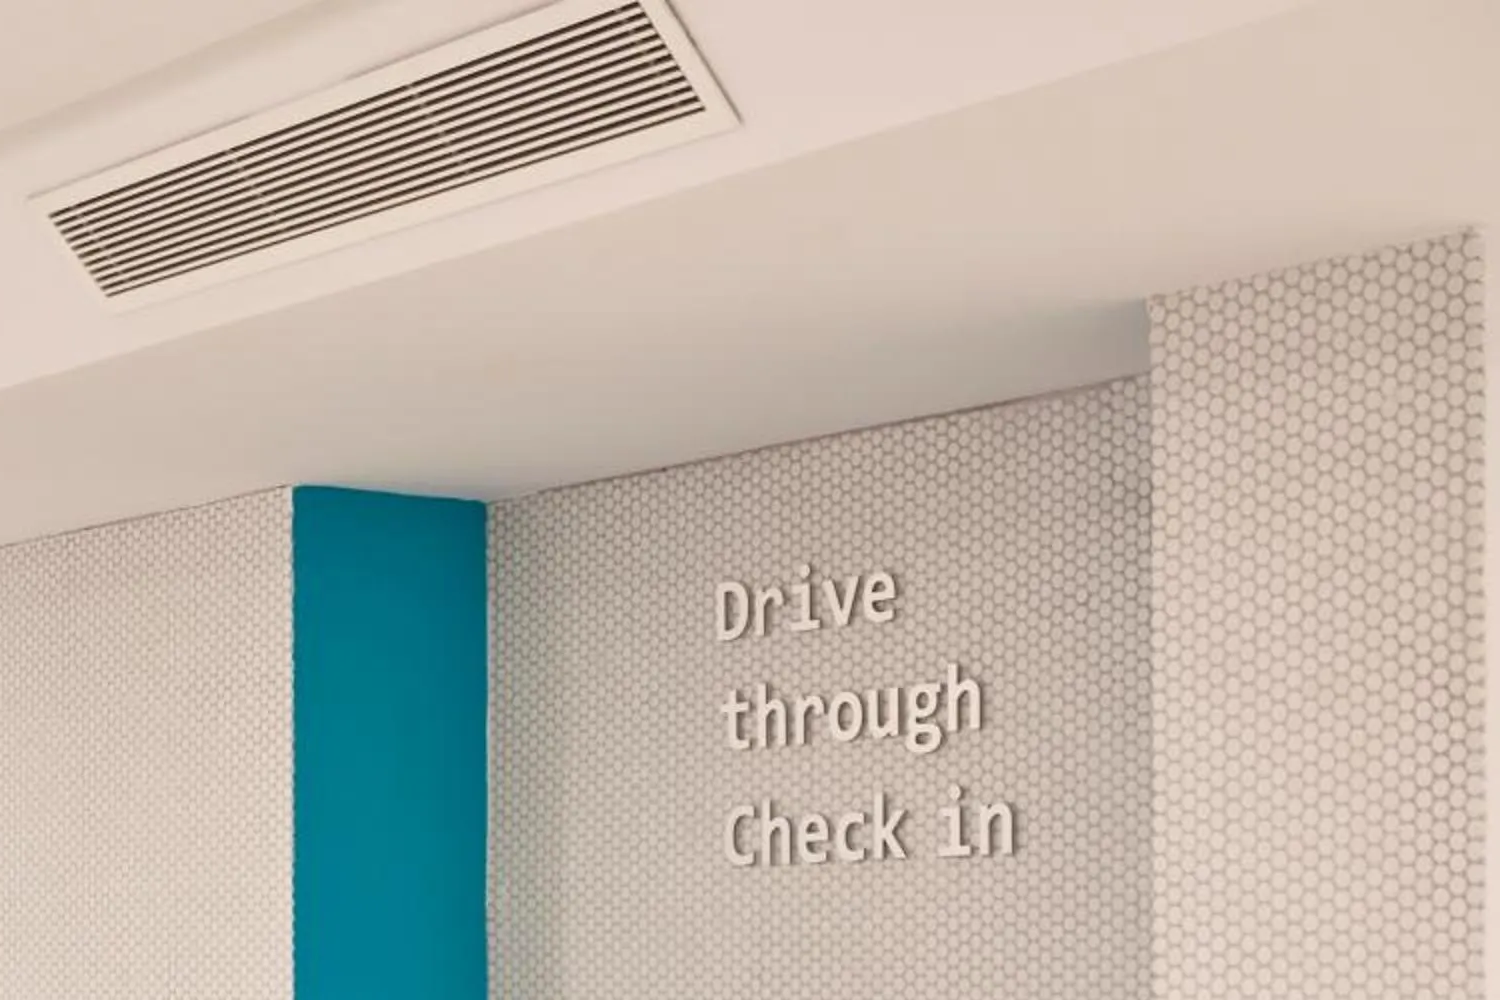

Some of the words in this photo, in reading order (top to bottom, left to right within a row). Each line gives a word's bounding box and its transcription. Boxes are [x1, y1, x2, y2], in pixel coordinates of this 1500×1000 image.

[716, 564, 897, 642] Drive
[721, 663, 982, 754] through
[724, 792, 909, 867] Check
[938, 784, 1015, 858] in
